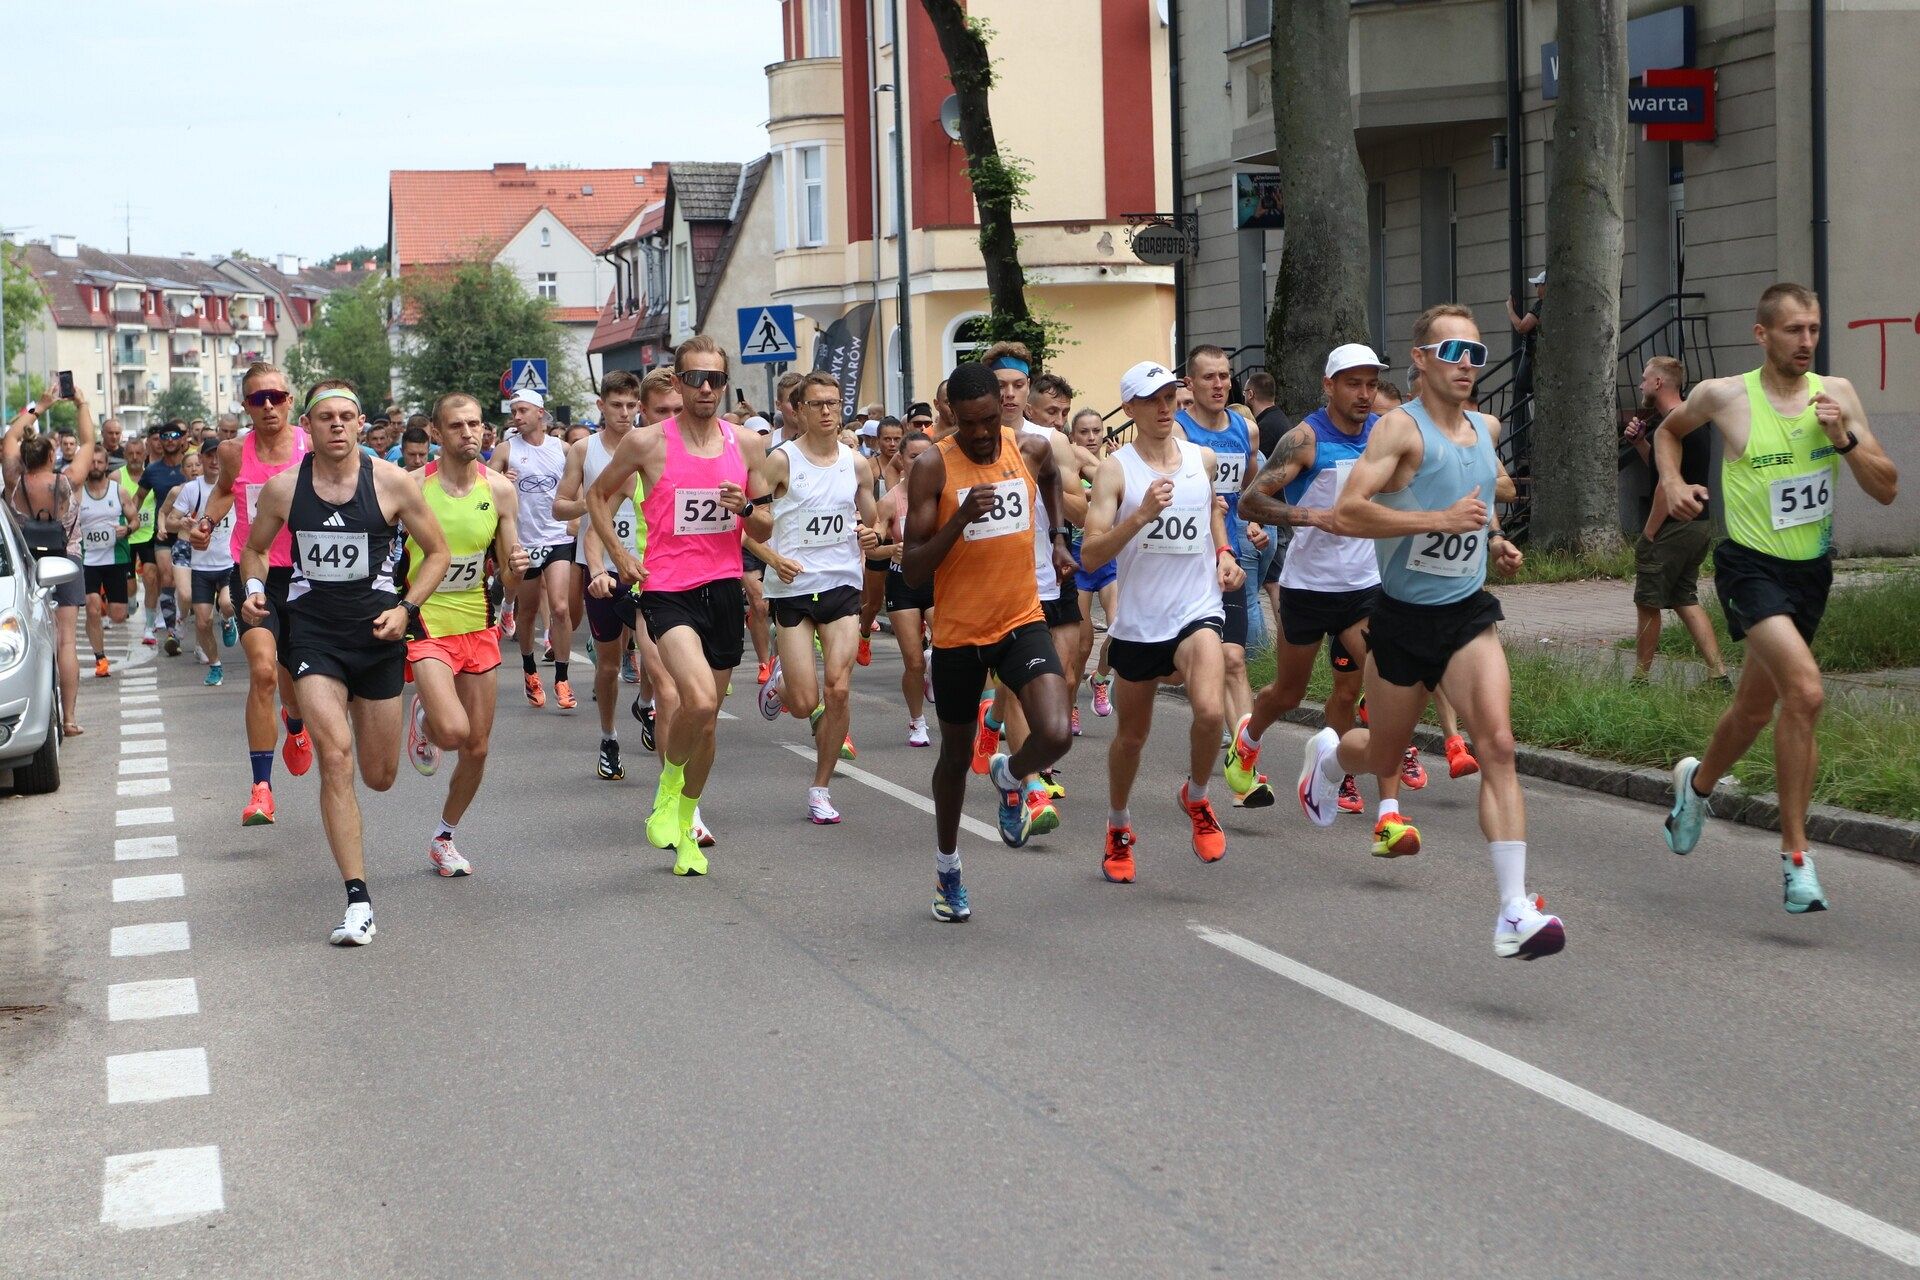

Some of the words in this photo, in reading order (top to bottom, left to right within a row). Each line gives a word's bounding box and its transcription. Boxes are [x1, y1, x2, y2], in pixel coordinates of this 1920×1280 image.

[1628, 97, 1688, 112] warta
[1138, 236, 1185, 255] EUROFOTO
[830, 346, 845, 384] RYKA
[843, 336, 862, 416] OKULARÓW
[1214, 462, 1239, 482] 91
[972, 491, 1022, 524] 83
[1781, 479, 1829, 513] 516
[86, 530, 110, 542] 480
[805, 514, 844, 536] 470
[1147, 516, 1198, 541] 206
[307, 543, 359, 569] 449
[527, 546, 549, 561] 66
[1421, 532, 1478, 561] 209
[441, 561, 478, 582] 75
